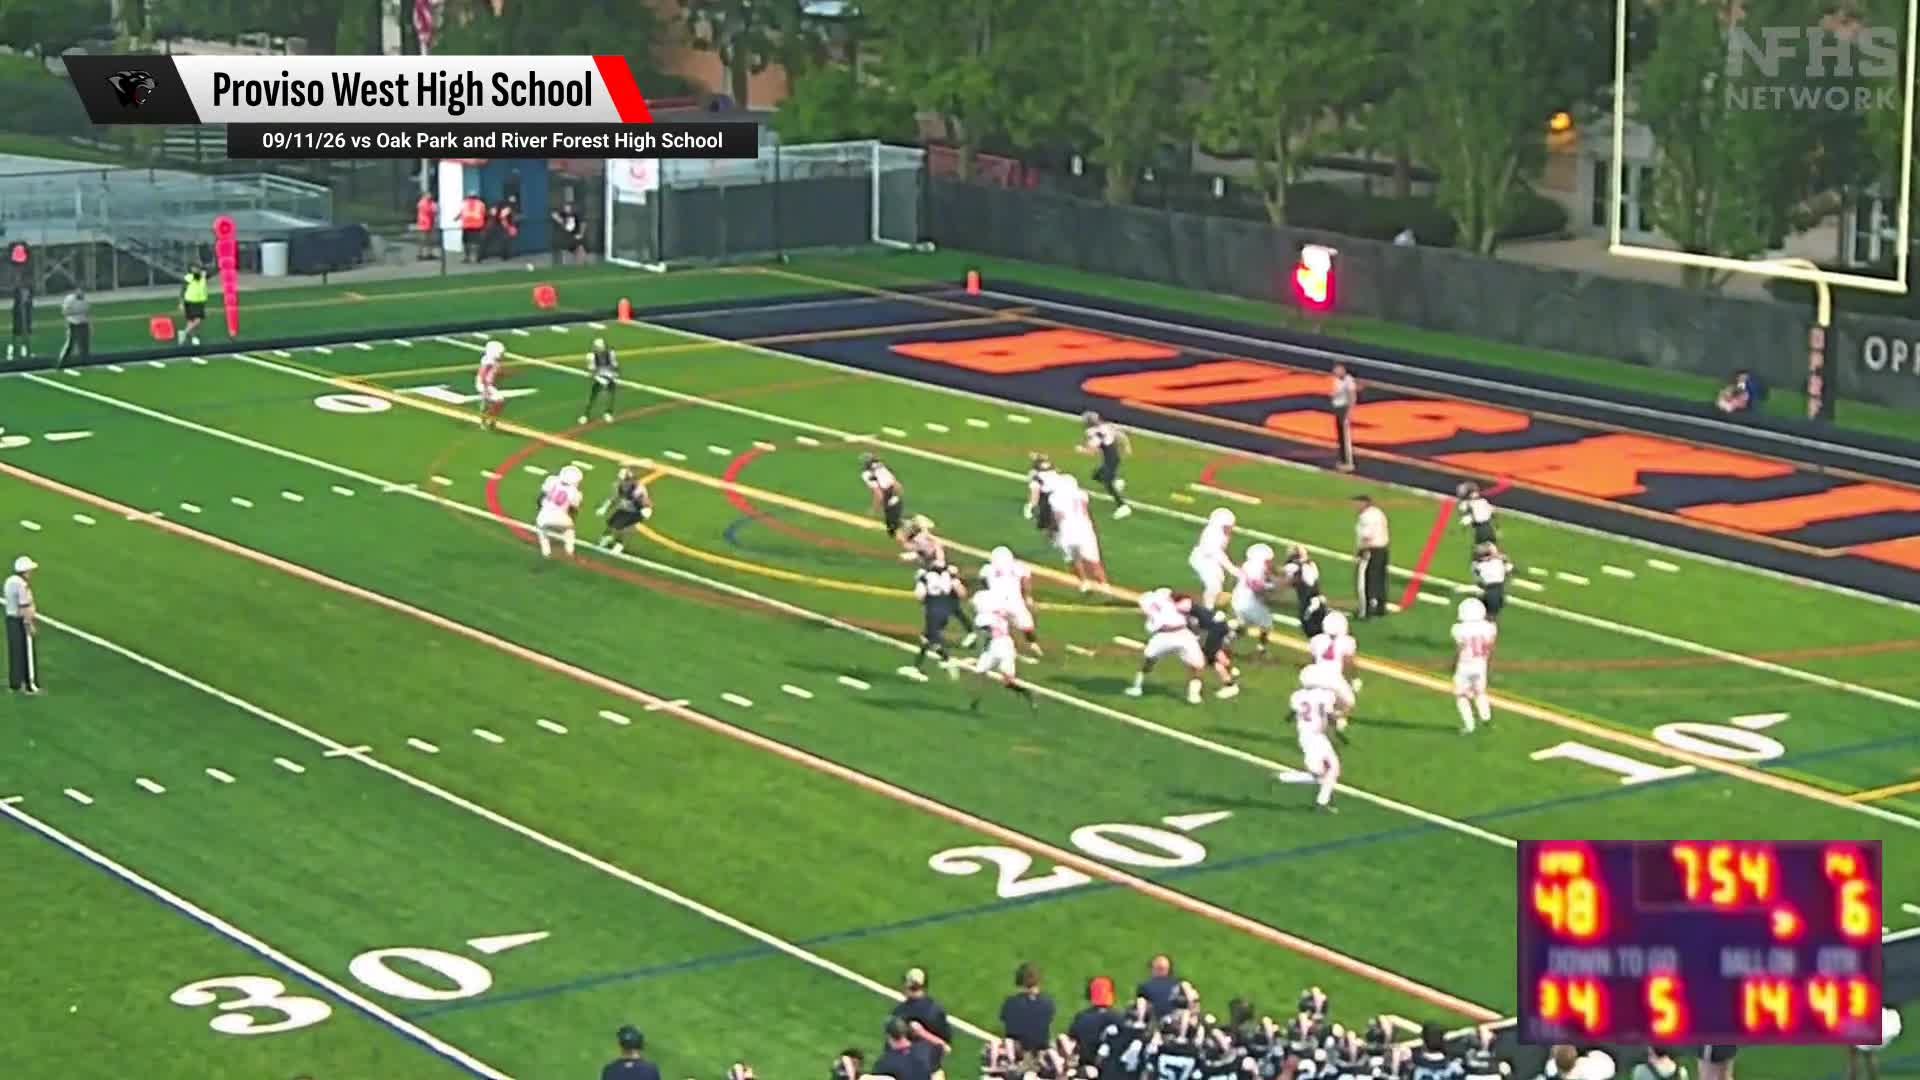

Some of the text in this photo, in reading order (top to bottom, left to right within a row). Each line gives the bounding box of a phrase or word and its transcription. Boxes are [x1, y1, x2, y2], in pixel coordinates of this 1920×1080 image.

[1530, 722, 1785, 786] 10
[928, 823, 1207, 899] 20
[1534, 876, 1599, 938] 48
[1840, 877, 1872, 938] 6
[169, 947, 493, 1035] 30
[1617, 946, 1643, 977] TO
[1567, 980, 1600, 1031] 4
[1647, 975, 1680, 1035] 5
[1743, 980, 1790, 1030] 14
[1807, 980, 1839, 1030] 4
